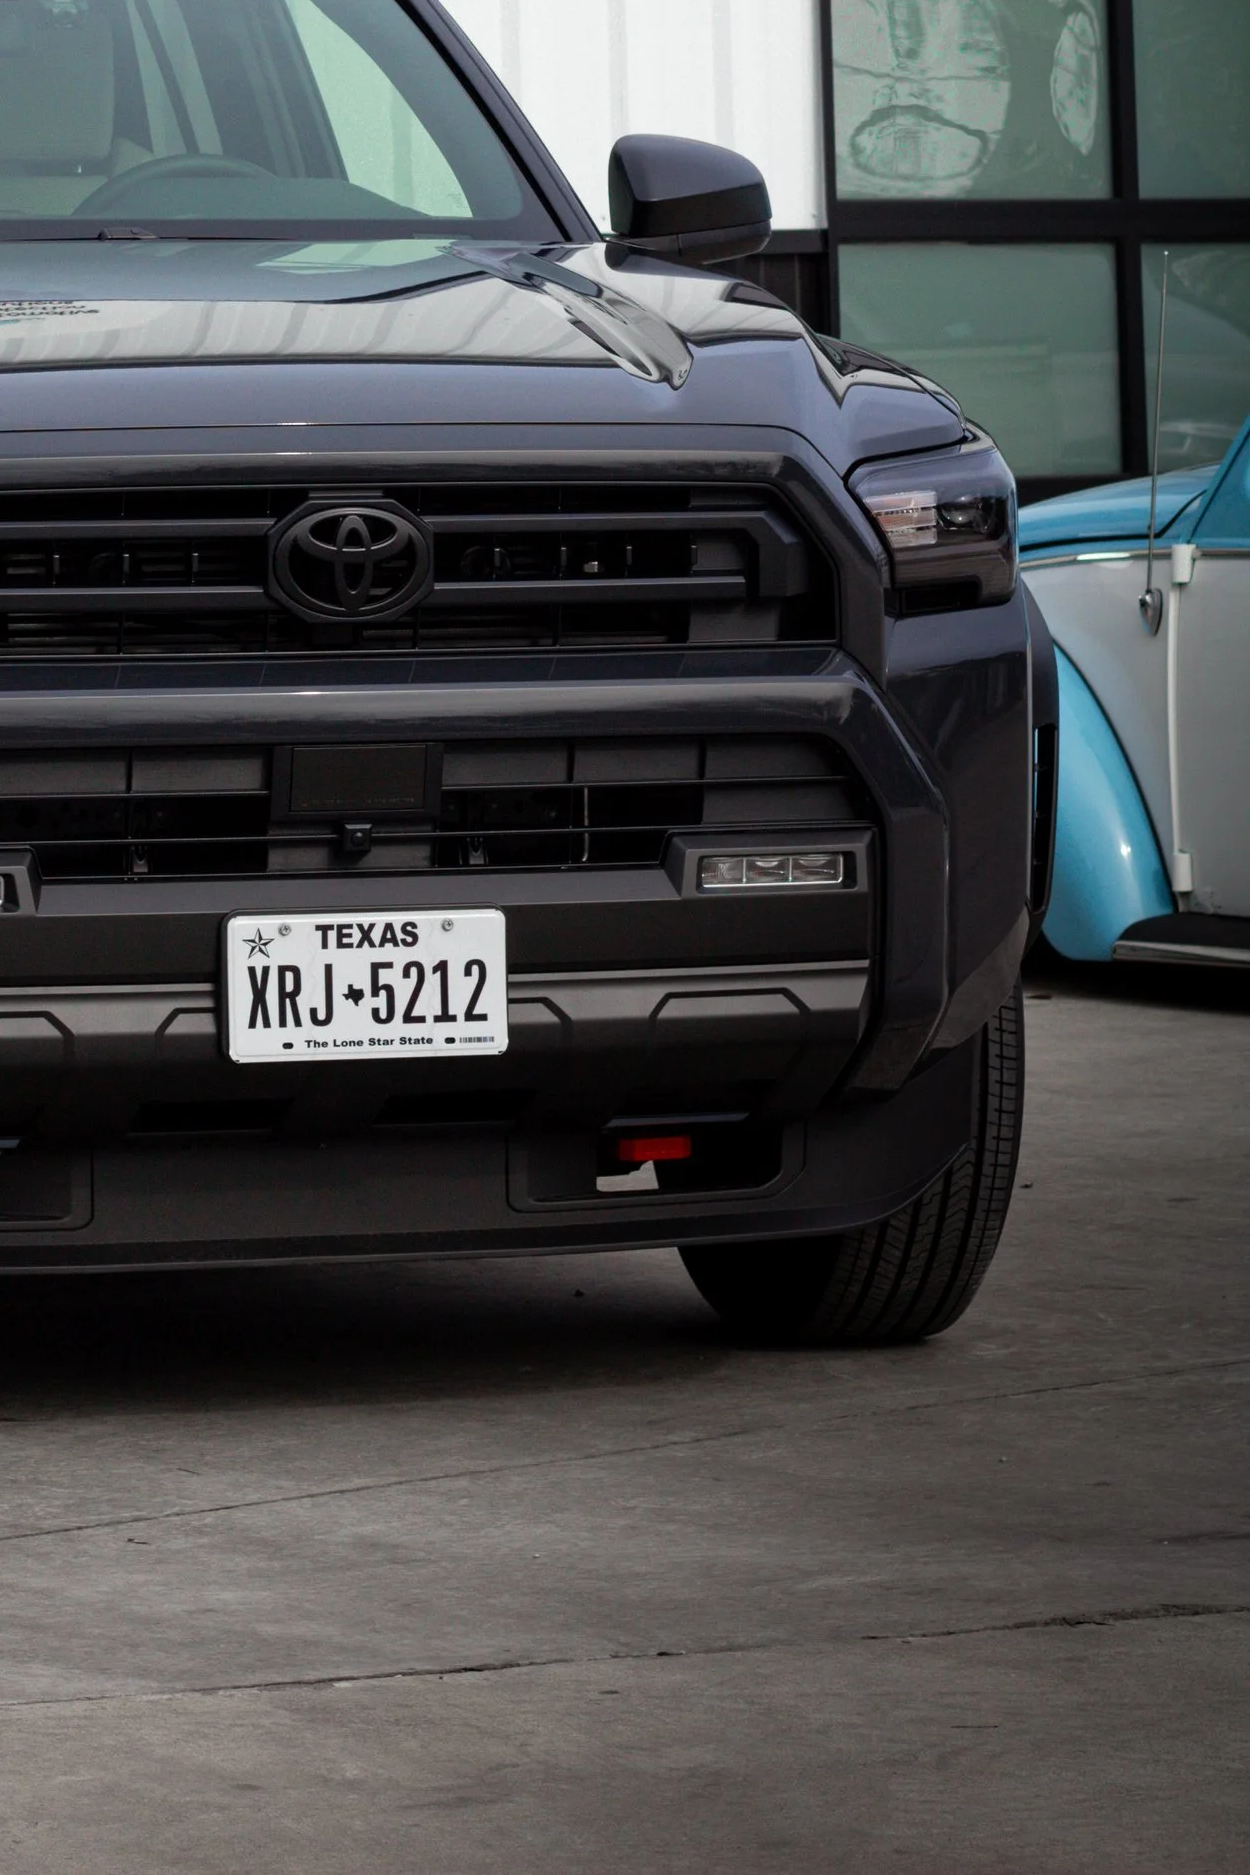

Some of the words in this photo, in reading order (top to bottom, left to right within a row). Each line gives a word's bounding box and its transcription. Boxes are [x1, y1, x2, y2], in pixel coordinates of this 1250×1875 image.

[315, 921, 419, 950] TEXAS
[247, 963, 334, 1029] XRJ
[370, 958, 488, 1025] 5212
[304, 1039, 329, 1049] The
[333, 1038, 364, 1047] Lone
[368, 1037, 395, 1046] Star
[399, 1036, 433, 1045] State
